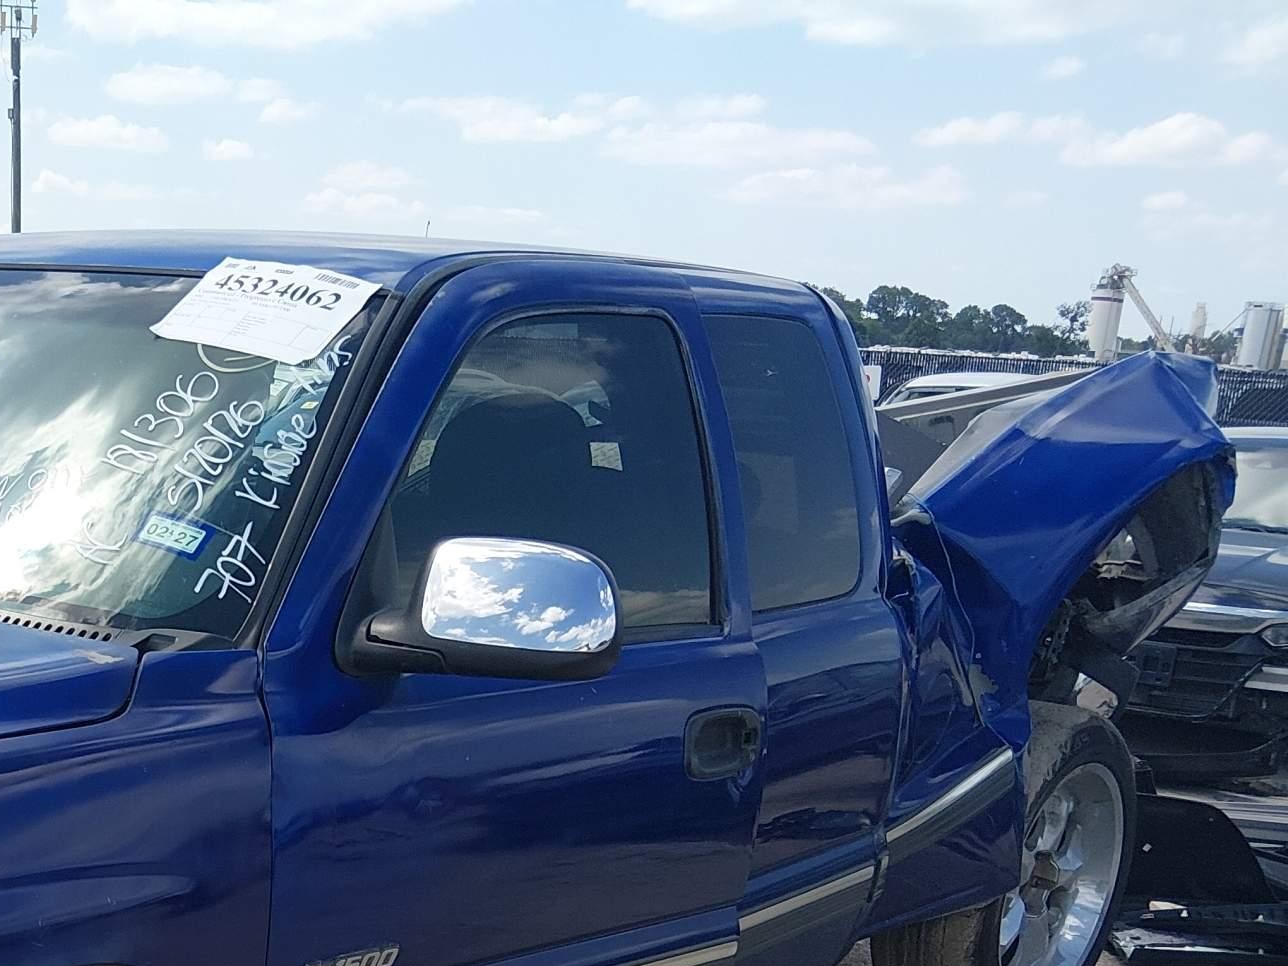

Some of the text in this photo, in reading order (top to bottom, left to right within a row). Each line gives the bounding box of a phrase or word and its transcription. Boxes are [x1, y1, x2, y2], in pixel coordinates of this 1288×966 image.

[215, 273, 343, 311] 45324062
[146, 523, 169, 538] 02
[174, 531, 199, 547] 27
